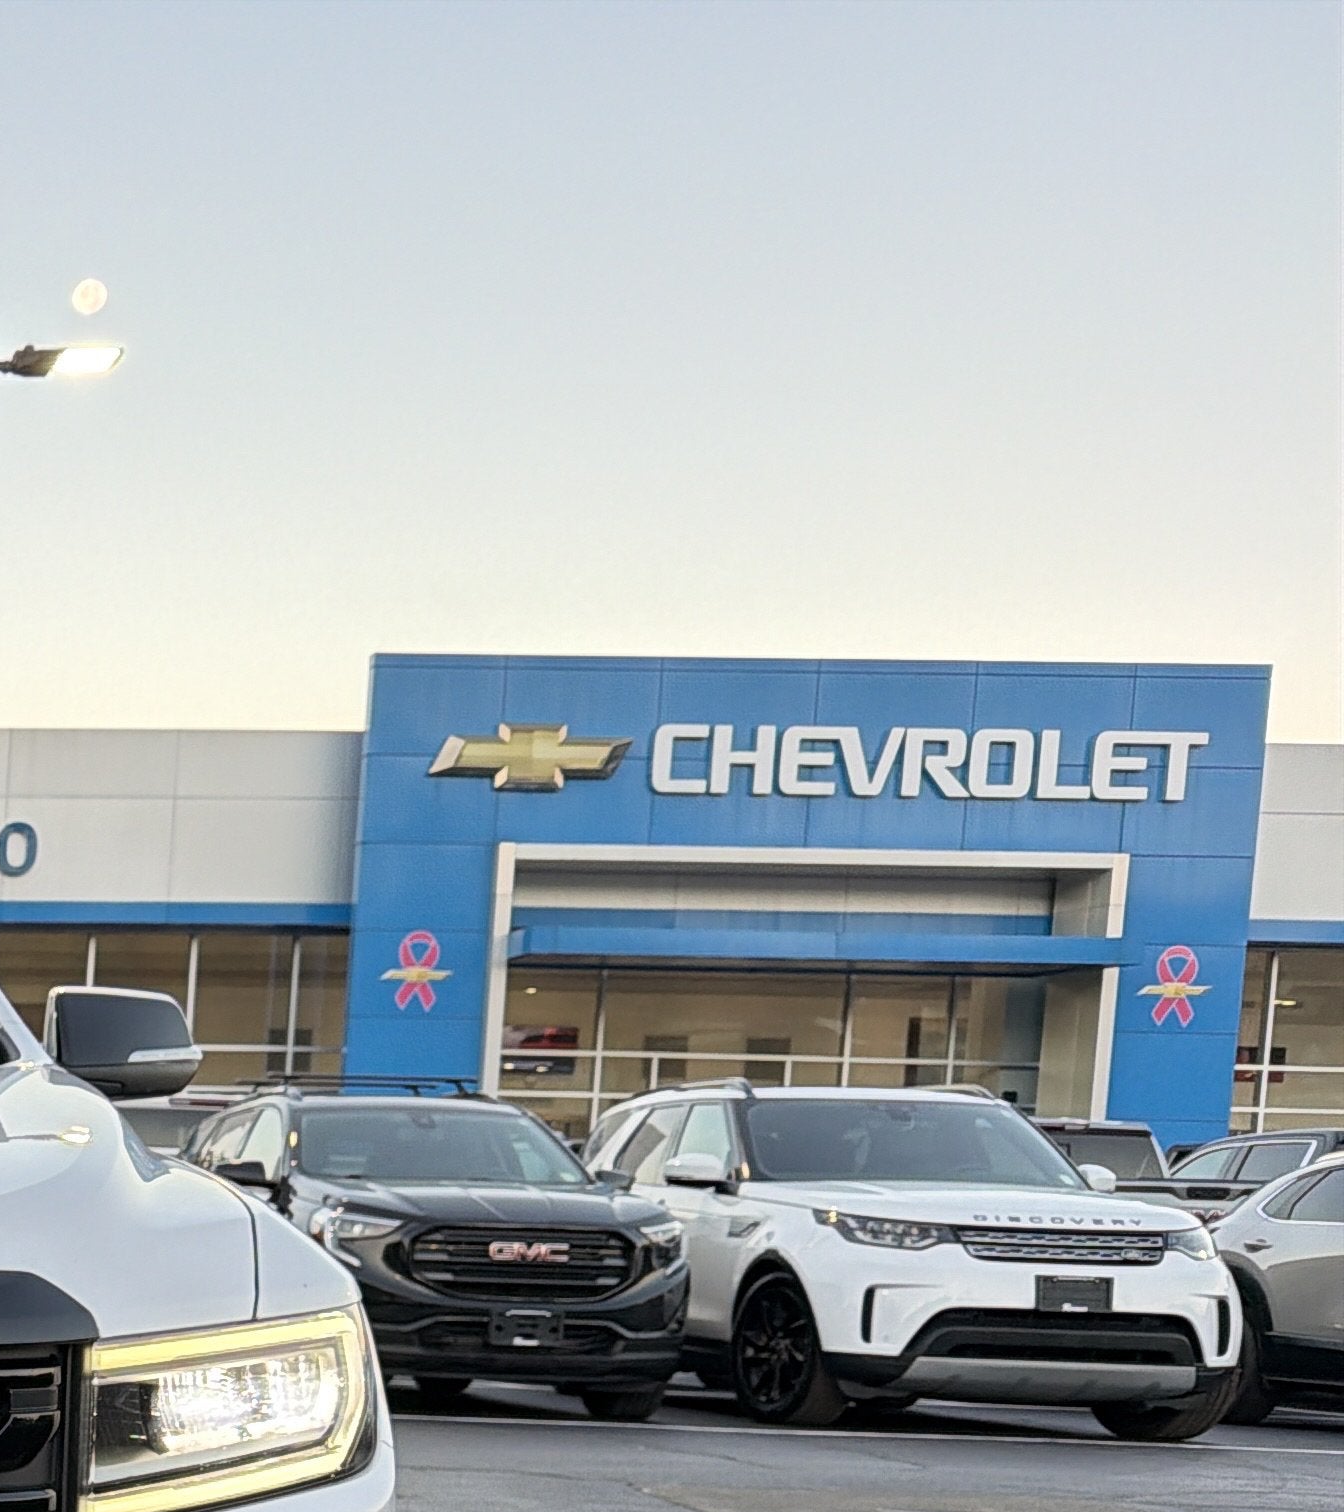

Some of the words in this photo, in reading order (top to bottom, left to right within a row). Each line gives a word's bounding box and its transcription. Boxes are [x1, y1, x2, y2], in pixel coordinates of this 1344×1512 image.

[650, 724, 1209, 801] CHEVROLET
[972, 1214, 1142, 1226] DISCOVERY
[488, 1241, 570, 1263] GMC
